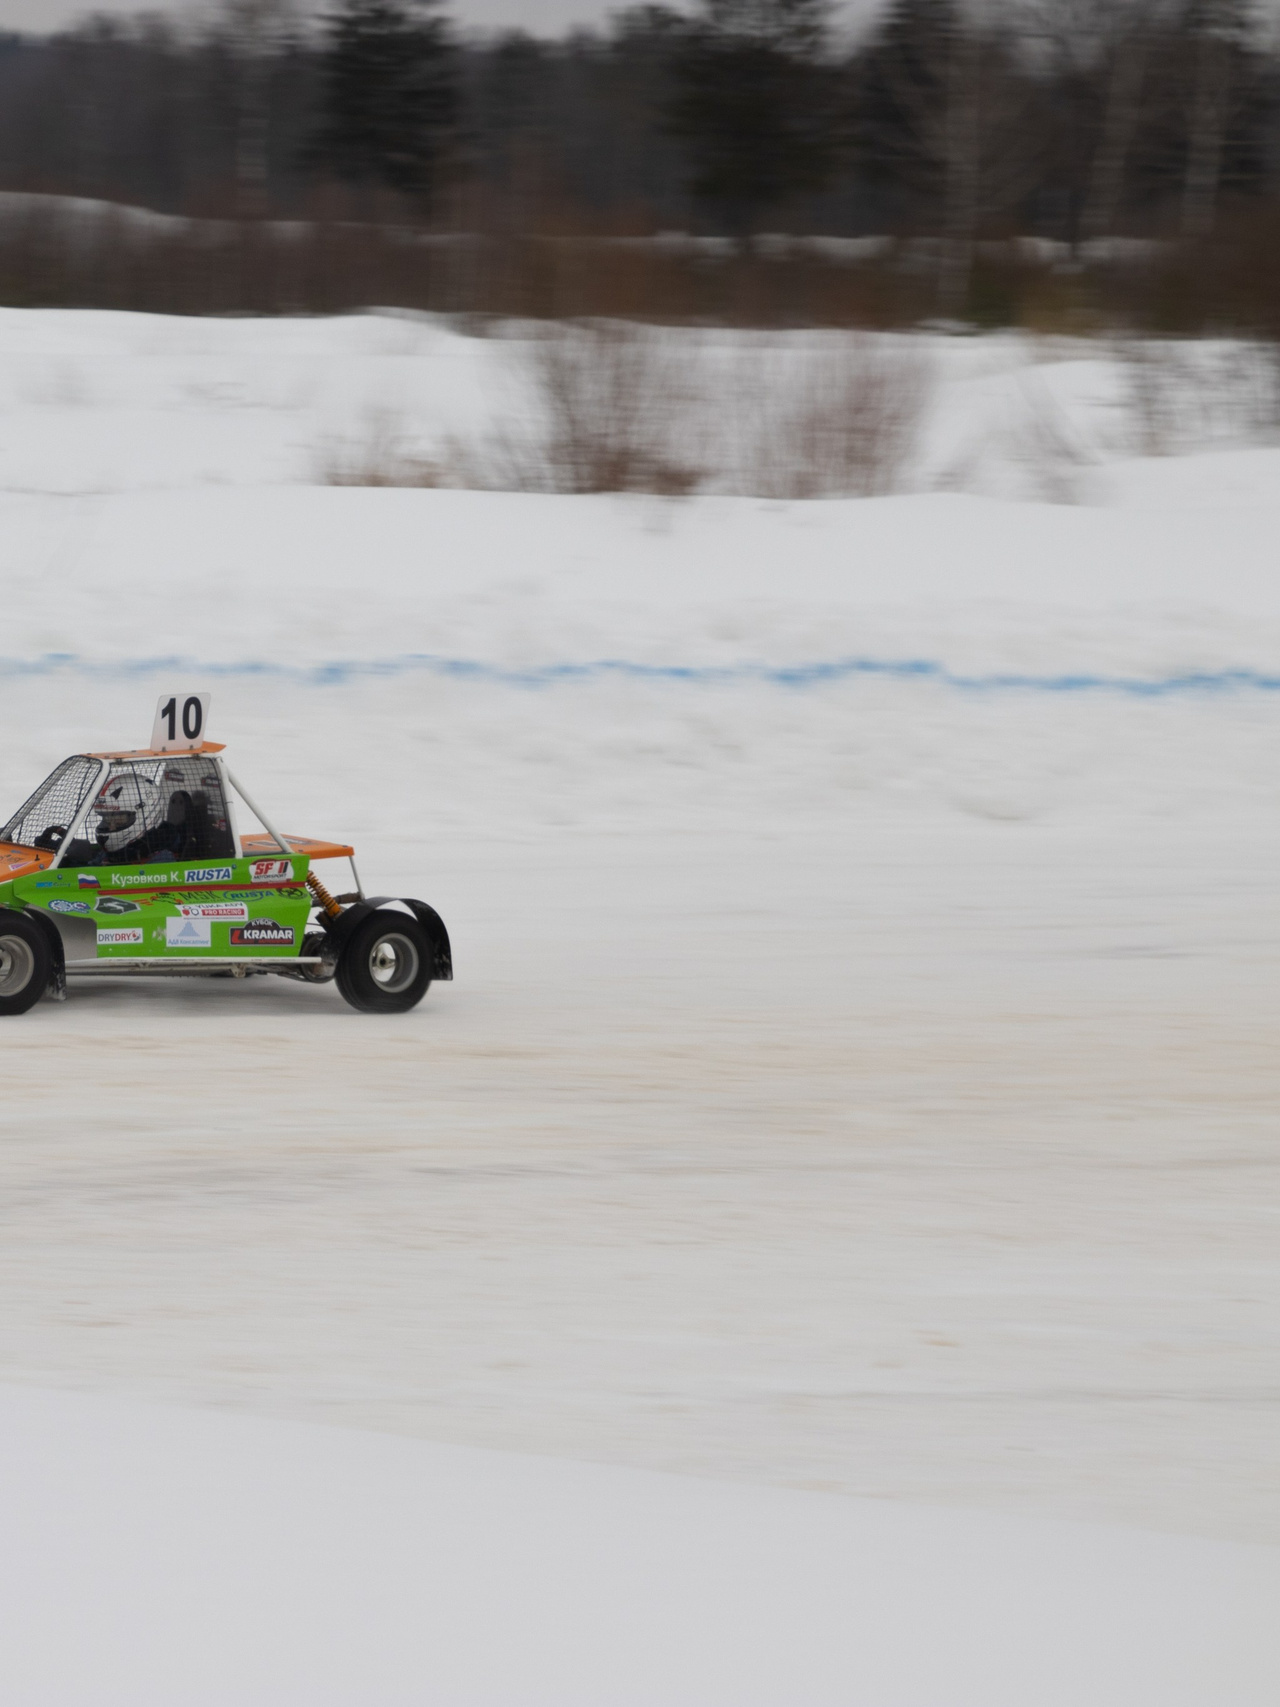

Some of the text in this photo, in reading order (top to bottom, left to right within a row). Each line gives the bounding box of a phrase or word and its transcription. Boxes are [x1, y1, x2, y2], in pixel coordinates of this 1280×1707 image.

[161, 696, 203, 740] 10
[186, 868, 231, 882] RUSTA
[255, 862, 274, 875] SF
[111, 873, 167, 887] Кузовков
[230, 889, 275, 899] RUSTA
[243, 929, 293, 939] KRAMAR
